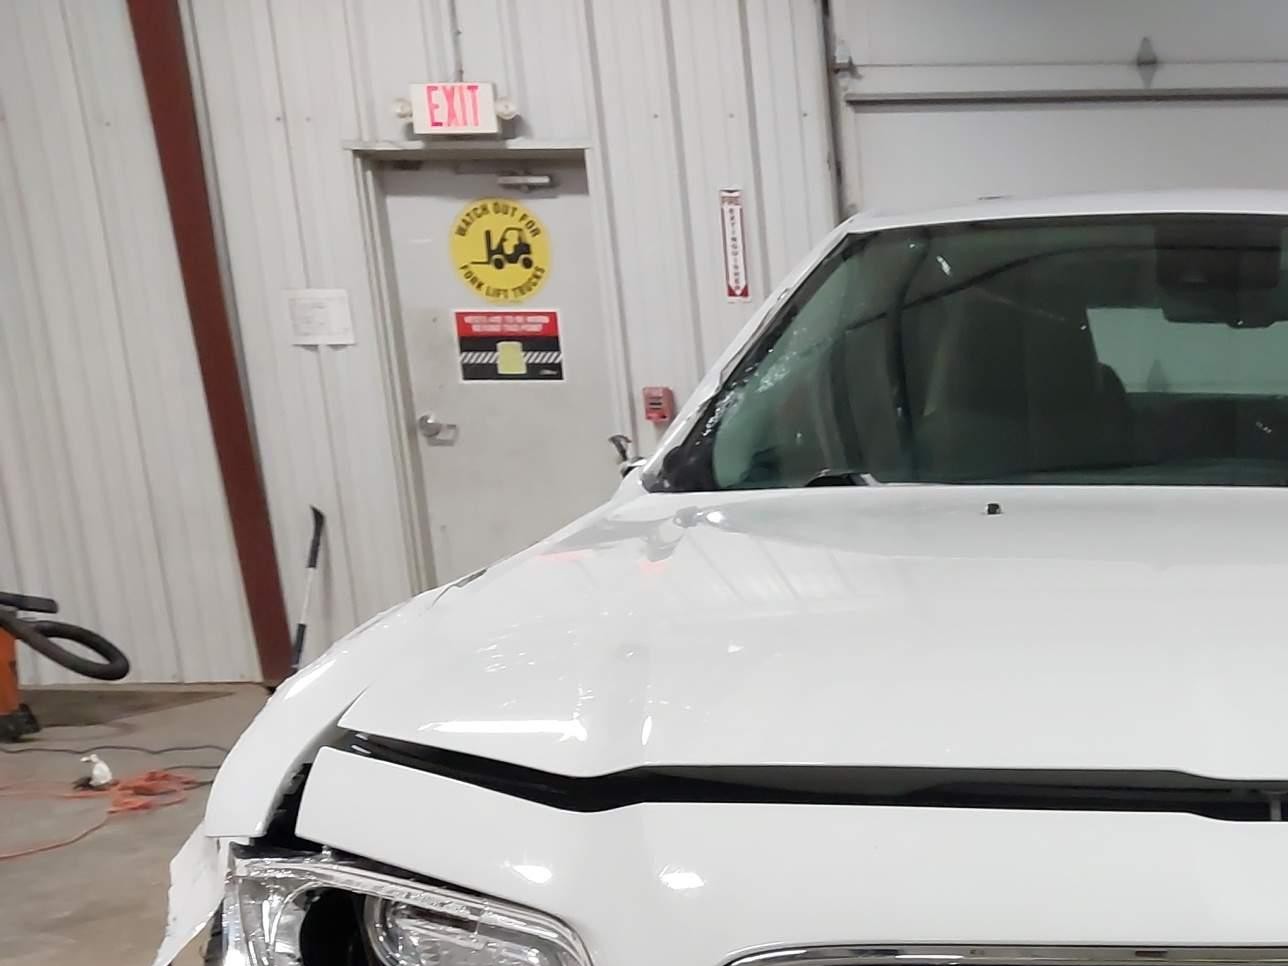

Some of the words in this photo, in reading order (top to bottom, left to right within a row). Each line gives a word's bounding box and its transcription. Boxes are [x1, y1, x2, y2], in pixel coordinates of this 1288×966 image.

[426, 85, 479, 127] EXIT
[455, 203, 489, 237] WATCH
[493, 202, 517, 217] OUT
[519, 213, 541, 237] FOR
[460, 264, 484, 291] FORK
[485, 286, 509, 299] LIFT
[511, 266, 545, 298] TRUCKS
